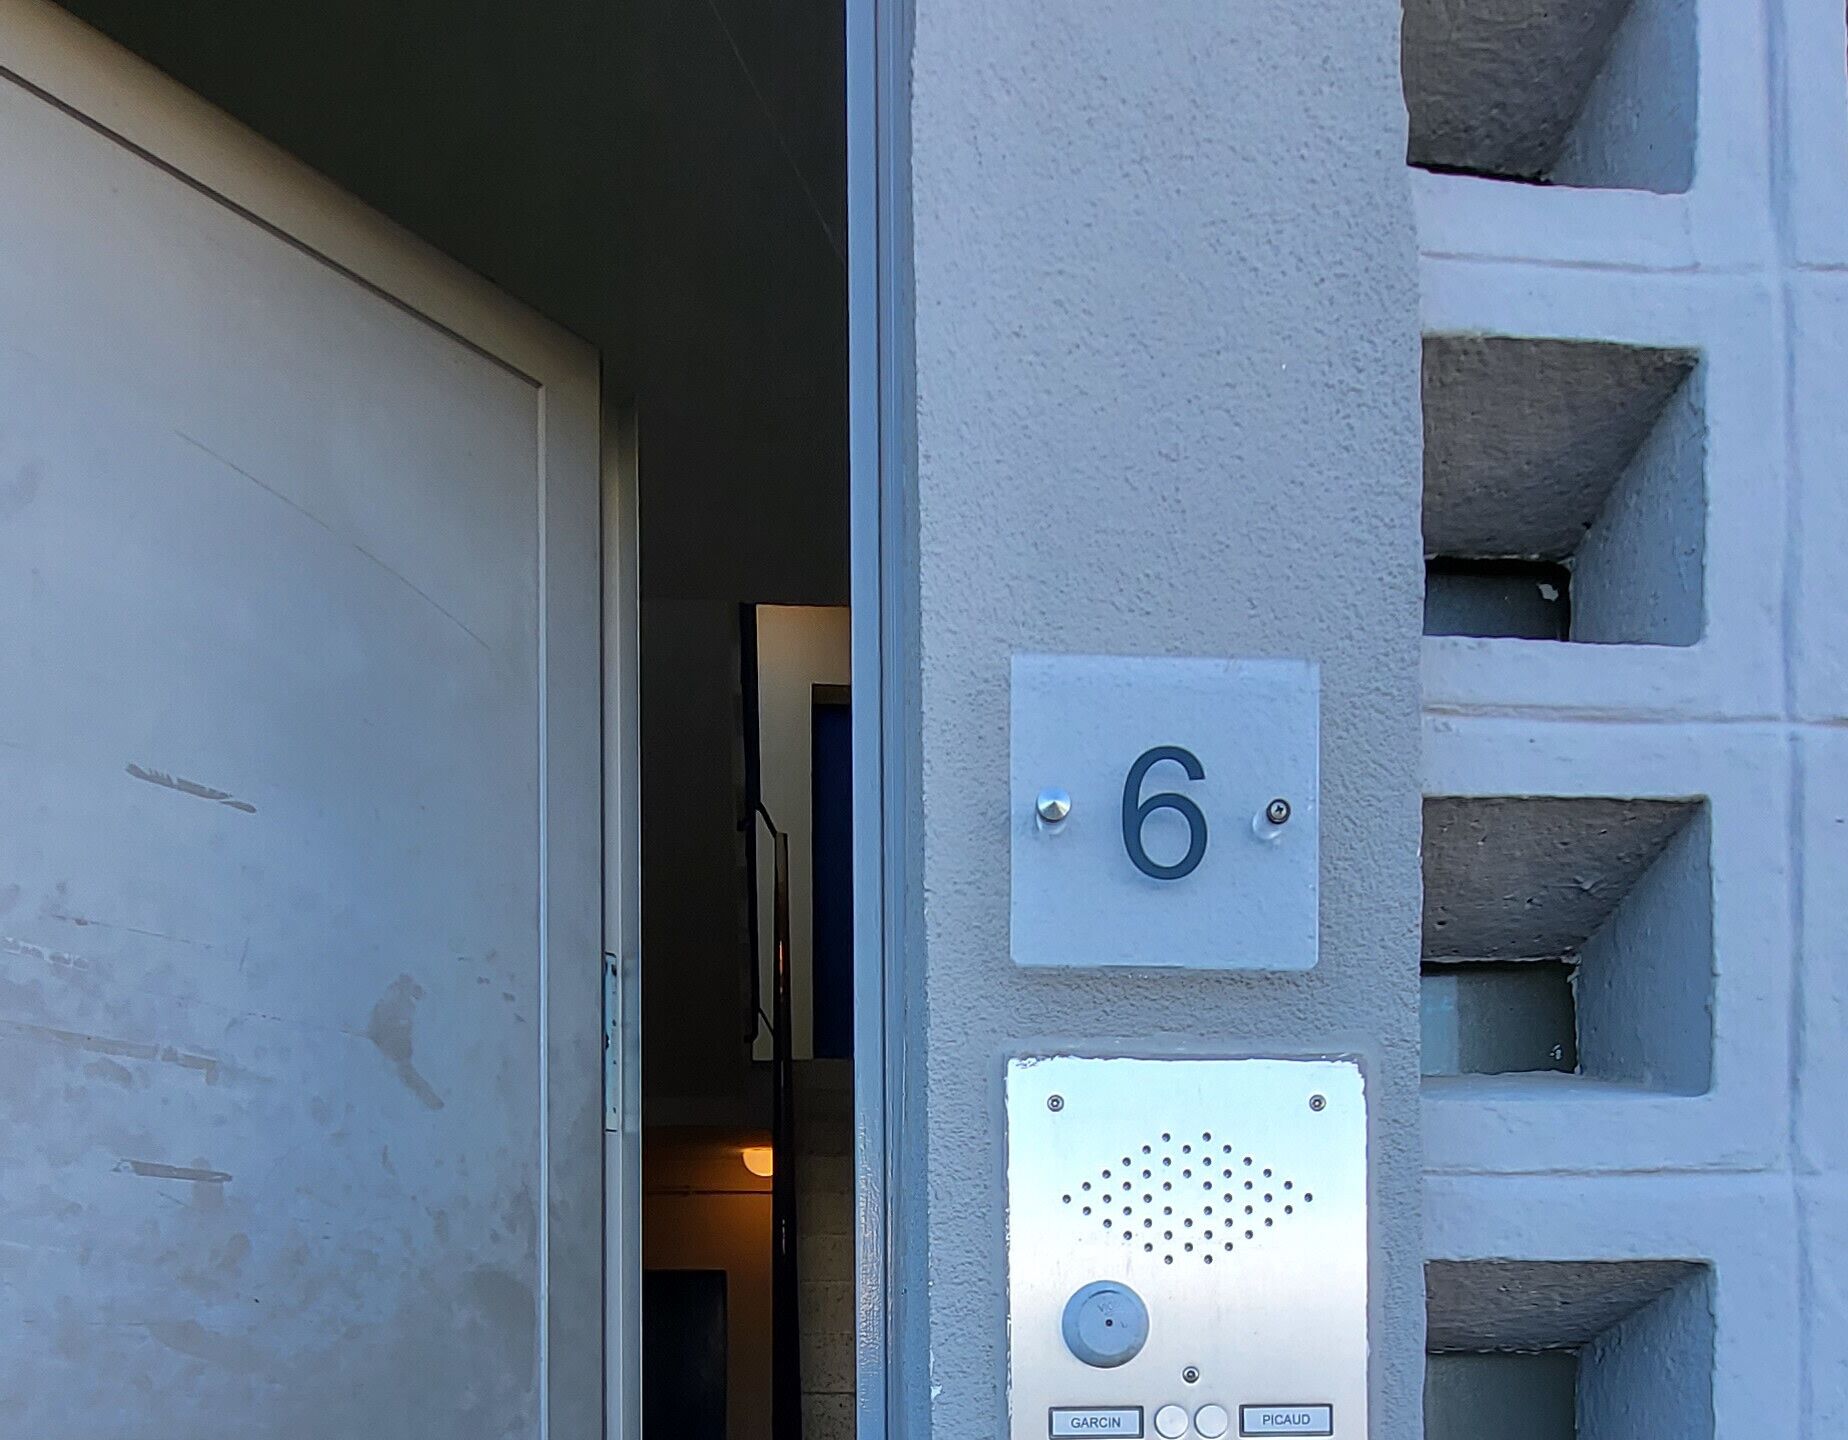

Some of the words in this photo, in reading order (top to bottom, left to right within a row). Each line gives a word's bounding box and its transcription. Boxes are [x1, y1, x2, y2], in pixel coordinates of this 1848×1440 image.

[1122, 745, 1208, 881] 6
[1070, 1416, 1121, 1428] GARCIN
[1262, 1413, 1311, 1426] PICAUD
